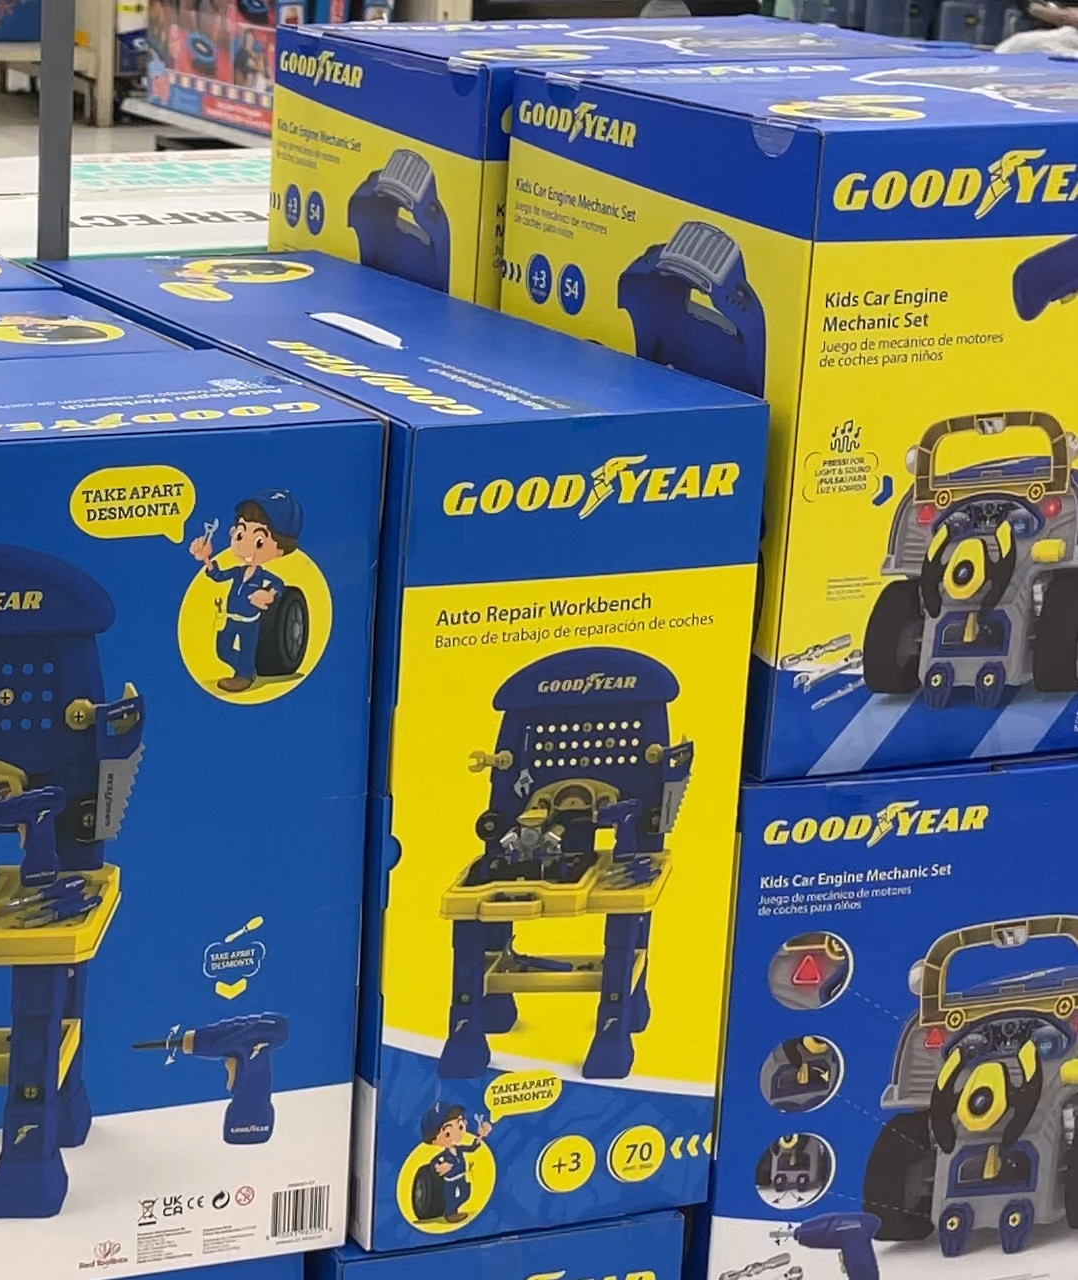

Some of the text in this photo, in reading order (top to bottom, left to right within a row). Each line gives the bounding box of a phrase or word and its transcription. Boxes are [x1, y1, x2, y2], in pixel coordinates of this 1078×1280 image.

[519, 101, 637, 148] GOODYEAR
[833, 148, 1078, 220] GOODYE
[548, 185, 577, 208] Engine
[578, 194, 620, 220] Mechanic
[621, 205, 637, 223] Set
[531, 271, 548, 290] +3
[563, 278, 579, 300] 54
[824, 288, 949, 309] Kids Car Engine
[823, 312, 929, 332] Mechanic Set
[820, 332, 1005, 356] Juego motores
[838, 349, 944, 368] coches para niños
[82, 483, 185, 505] TAKE APART
[443, 454, 741, 519] GOODYEAR
[86, 501, 181, 522] DESMONTA
[436, 592, 652, 627] Auto Repair Workbench
[435, 613, 715, 649] Banco de trabajo de reparación de coches
[538, 673, 638, 695] GOODYEAR
[763, 799, 990, 849] GOODYEAR
[760, 863, 952, 889] Kids Car Engine Mechanic Set
[491, 1077, 557, 1095] TAKE APART
[493, 1091, 554, 1106] DESMONTA
[552, 1152, 582, 1174] +3
[625, 1142, 653, 1164] 70
[163, 1195, 183, 1207] UK
